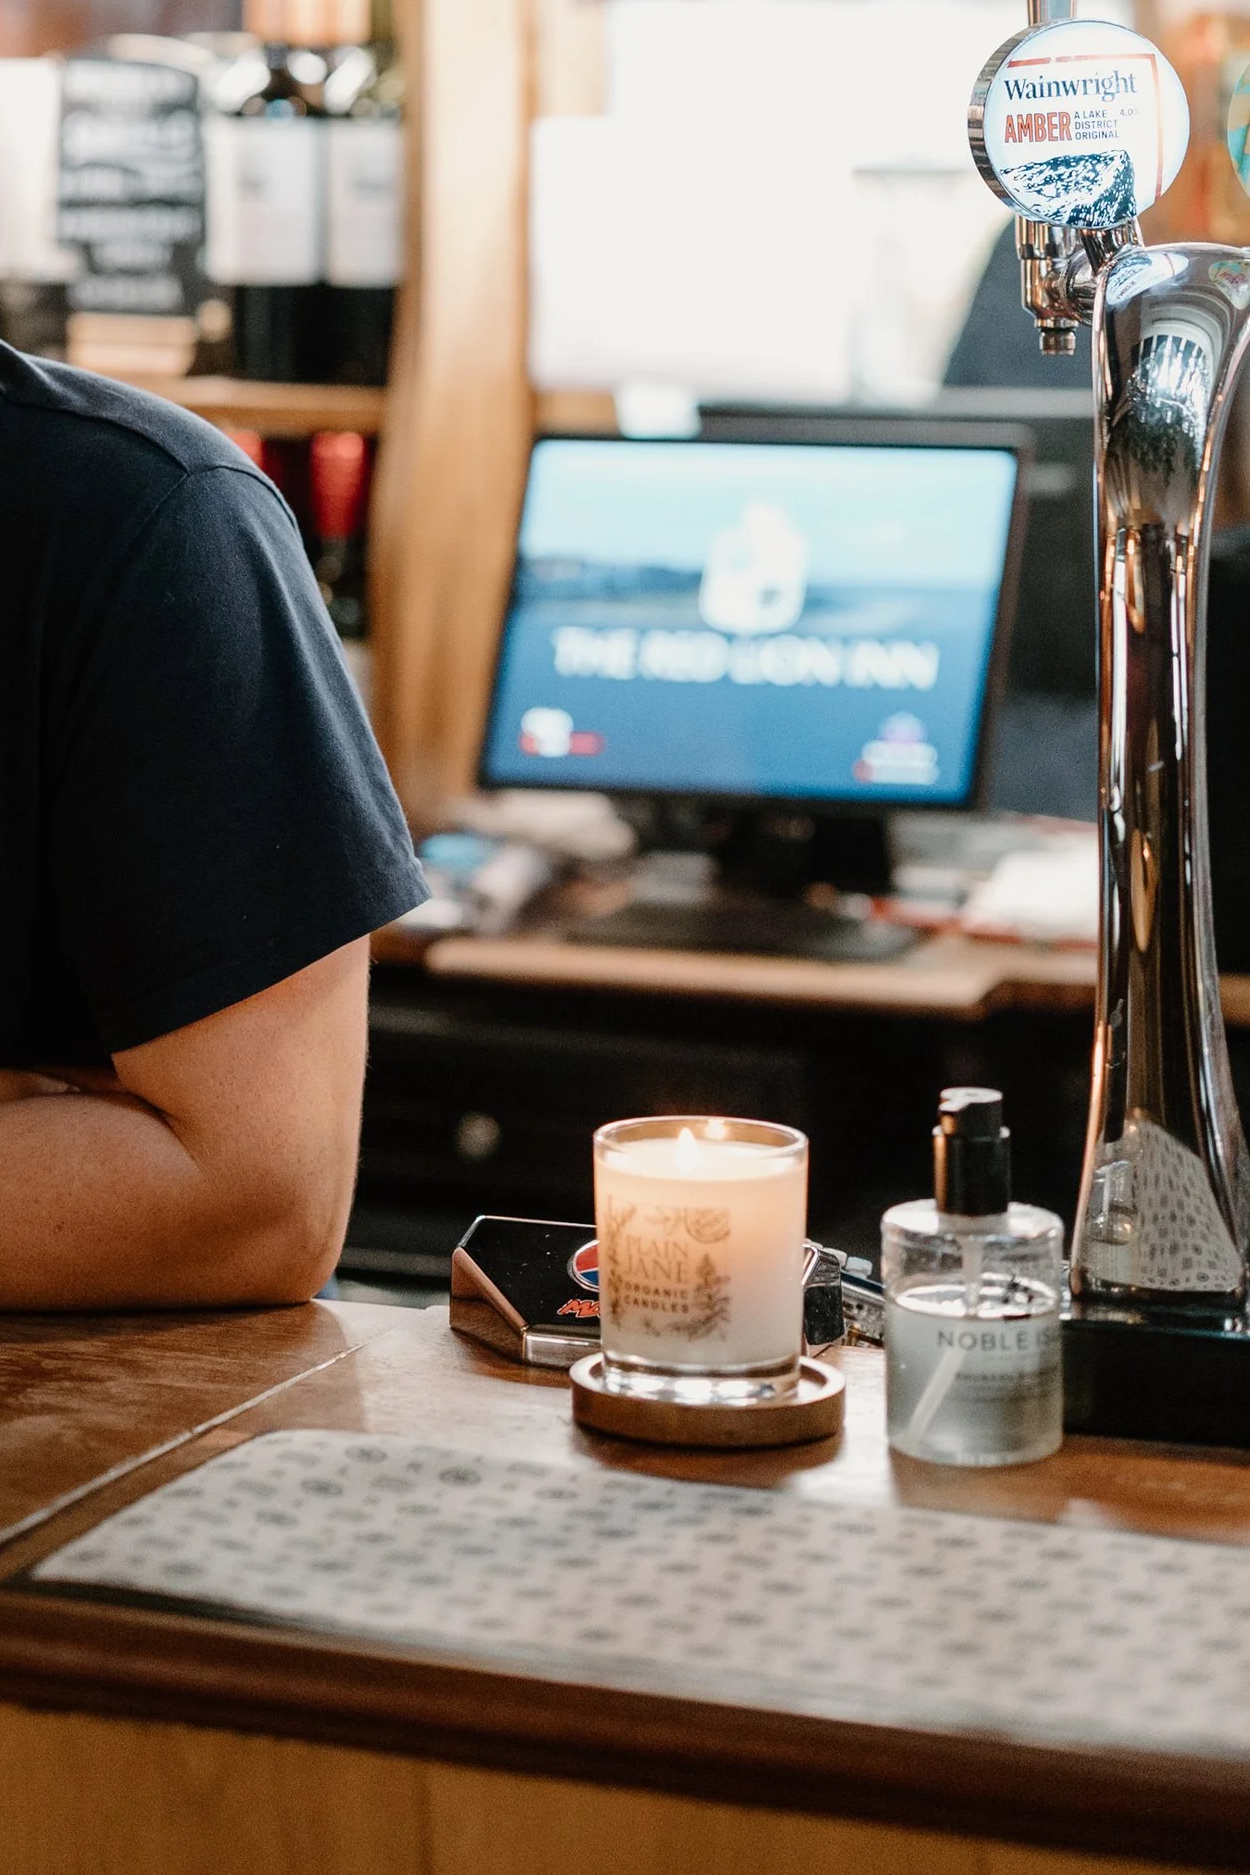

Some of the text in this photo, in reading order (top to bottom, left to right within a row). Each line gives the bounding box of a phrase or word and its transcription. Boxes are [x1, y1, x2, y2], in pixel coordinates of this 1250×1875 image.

[1004, 70, 1138, 102] Wainwright
[1074, 110, 1107, 119] A LAKE
[1074, 119, 1118, 130] DISTRICT
[1004, 111, 1072, 143] AMBER
[1075, 130, 1120, 141] ORIGINAL
[626, 1233, 689, 1258] PLAIN
[623, 1255, 690, 1284] JANE
[624, 1282, 688, 1300] ORGANIC
[623, 1293, 689, 1314] CANDLES
[936, 1330, 1028, 1351] NOBLE
